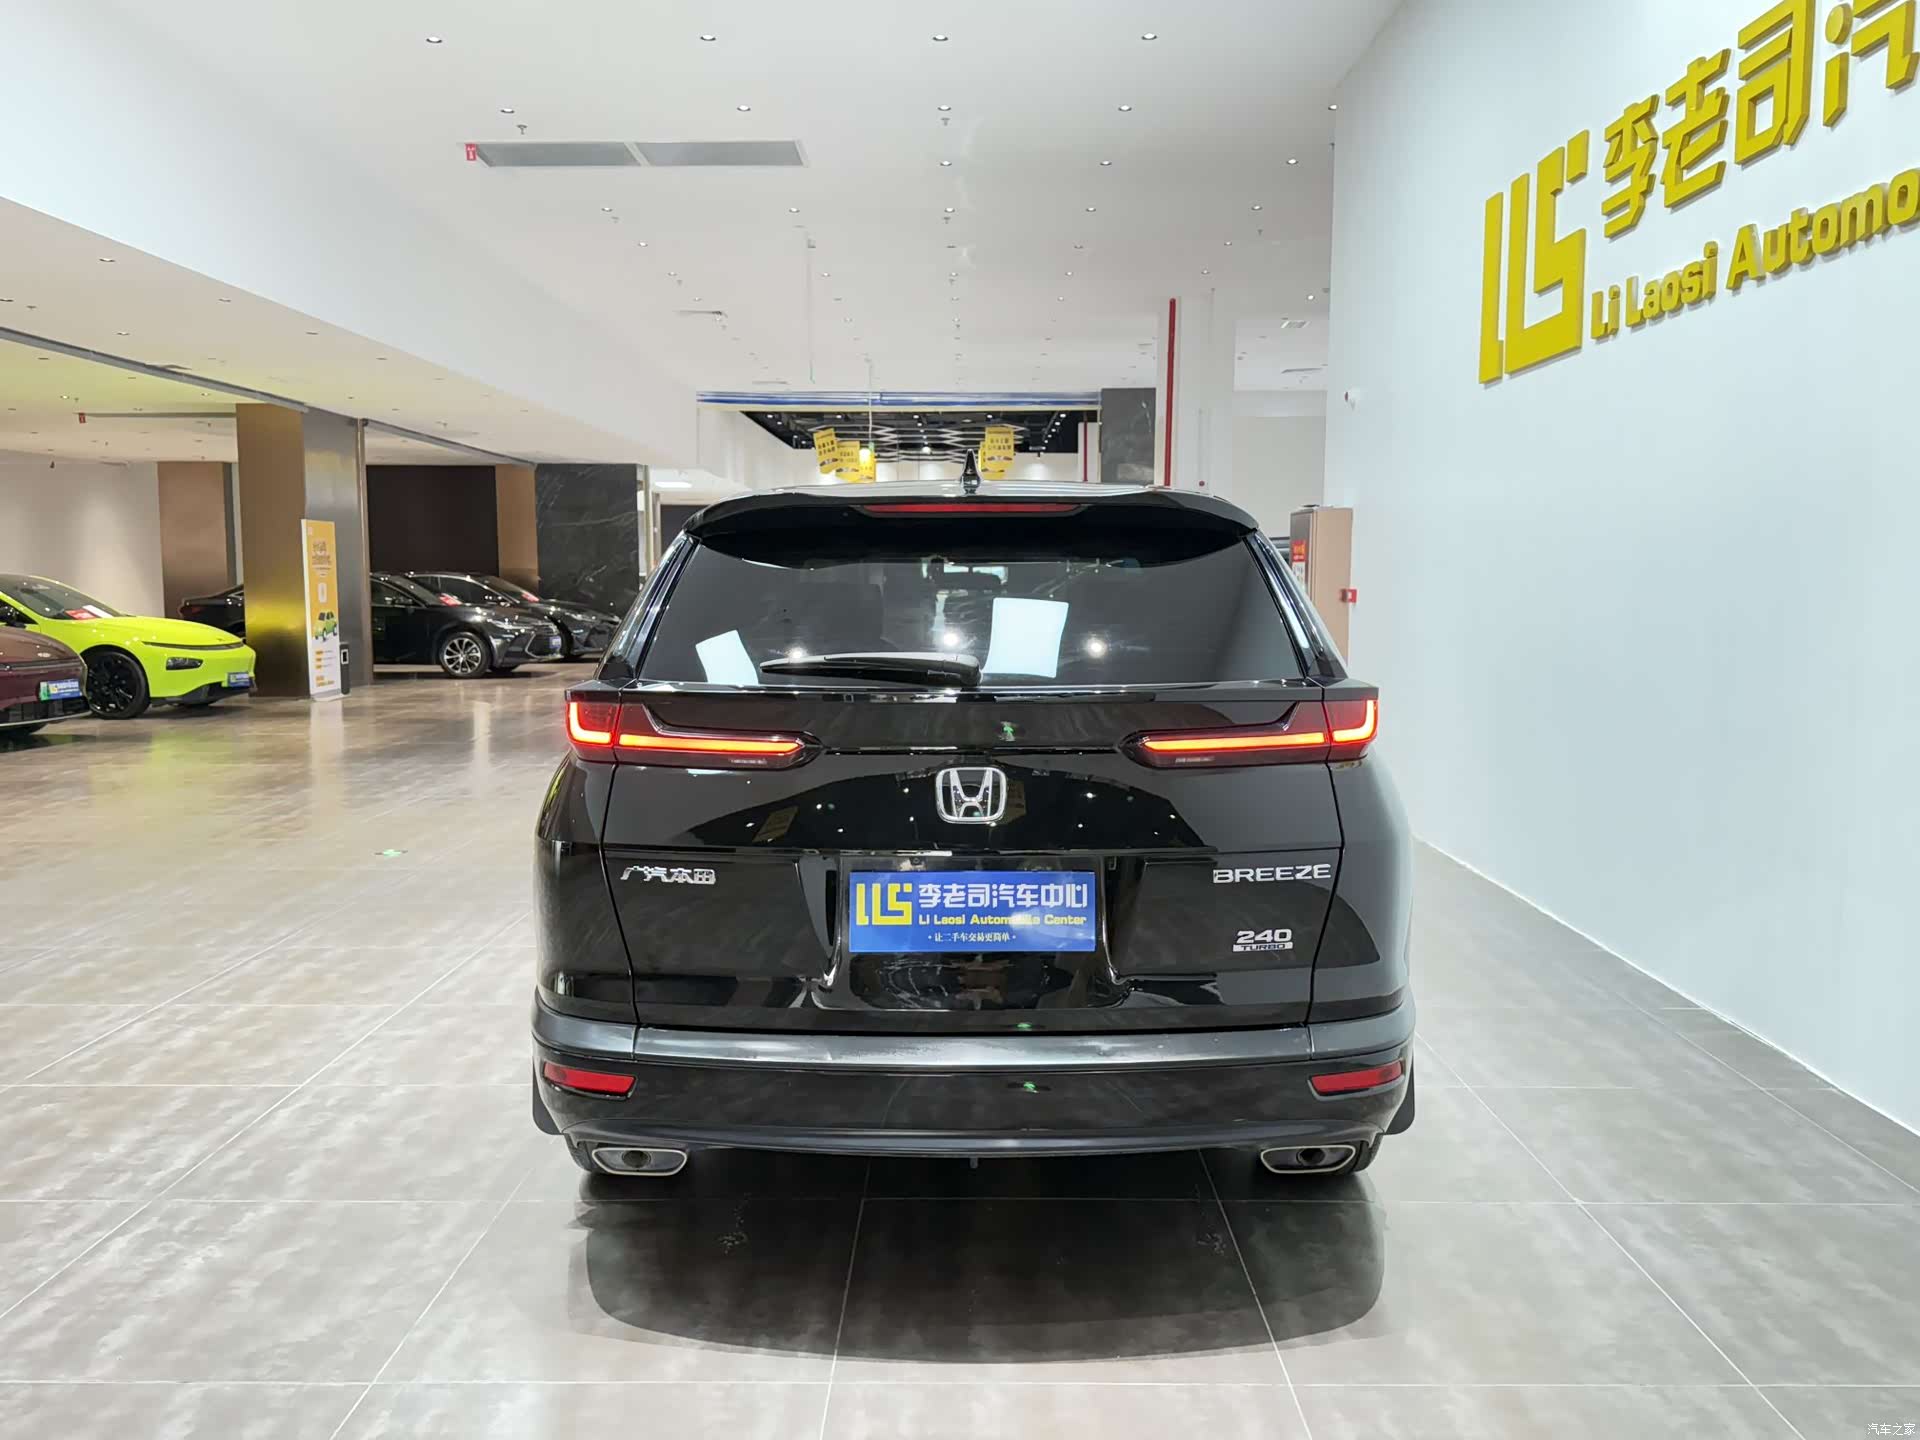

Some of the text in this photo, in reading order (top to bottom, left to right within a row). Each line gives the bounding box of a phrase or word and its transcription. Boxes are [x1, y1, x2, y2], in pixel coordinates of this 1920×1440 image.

[1590, 168, 1920, 340] Li Laosi Automo
[619, 865, 716, 885] 广汽本田
[1212, 863, 1332, 884] BREEZE
[918, 883, 1087, 909] 李老司汽车中心
[918, 914, 1087, 926] Li Laosi Automle Center
[1236, 928, 1293, 944] 240
[1240, 943, 1287, 952] TURBO
